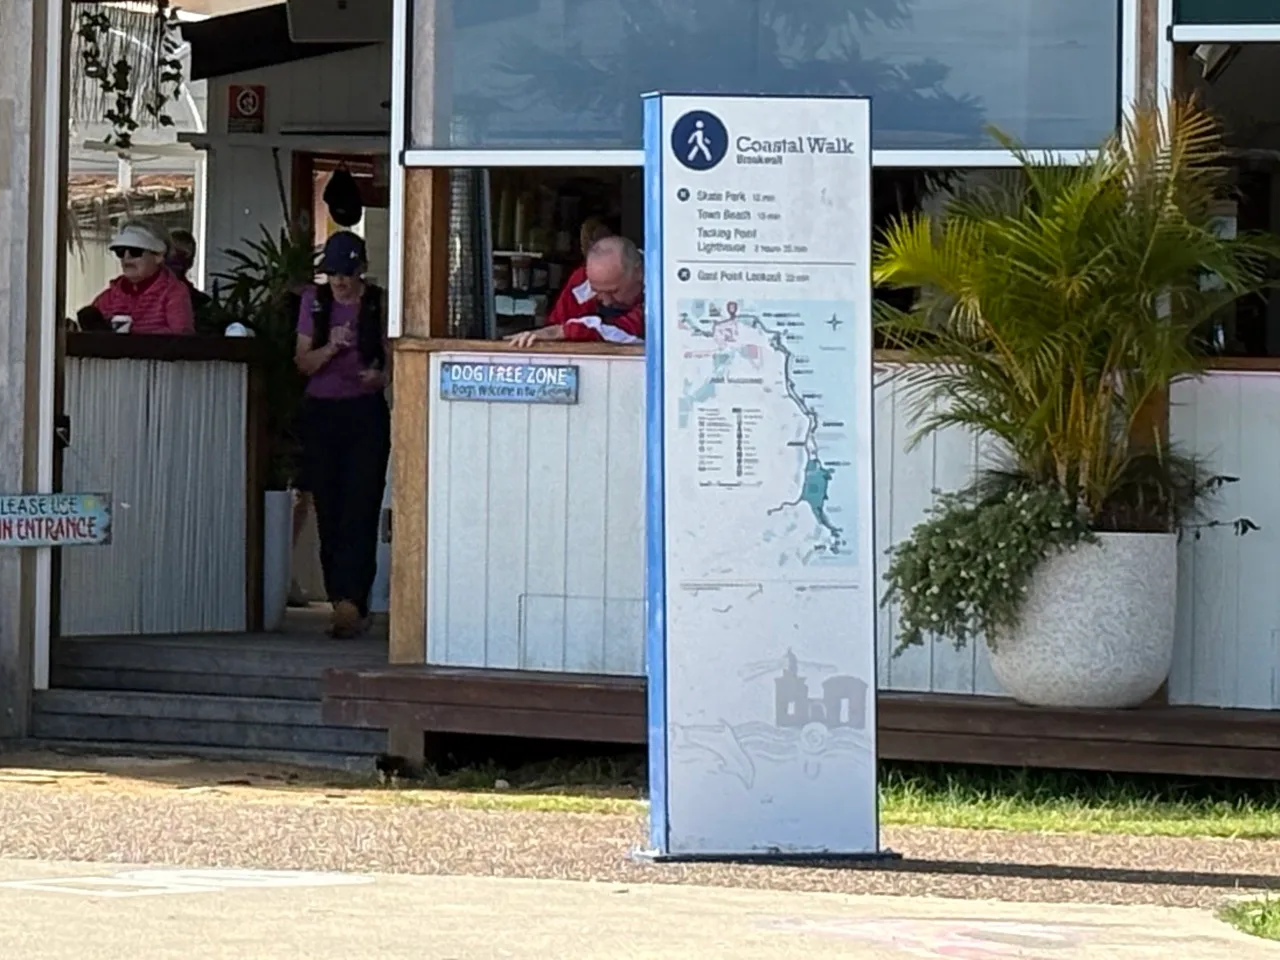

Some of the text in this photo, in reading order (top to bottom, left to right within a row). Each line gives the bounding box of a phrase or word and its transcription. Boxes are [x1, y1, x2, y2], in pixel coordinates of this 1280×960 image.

[736, 136, 854, 154] Coastal Walk
[725, 191, 746, 202] Park
[697, 209, 721, 220] Town
[724, 209, 751, 220] Beach
[734, 228, 757, 239] Point
[697, 242, 746, 254] Lighthouse
[451, 365, 568, 385] DOG FREE ZONE
[451, 384, 475, 397] Dogs
[50, 497, 79, 515] USE
[17, 516, 98, 541] ENTRANCE
